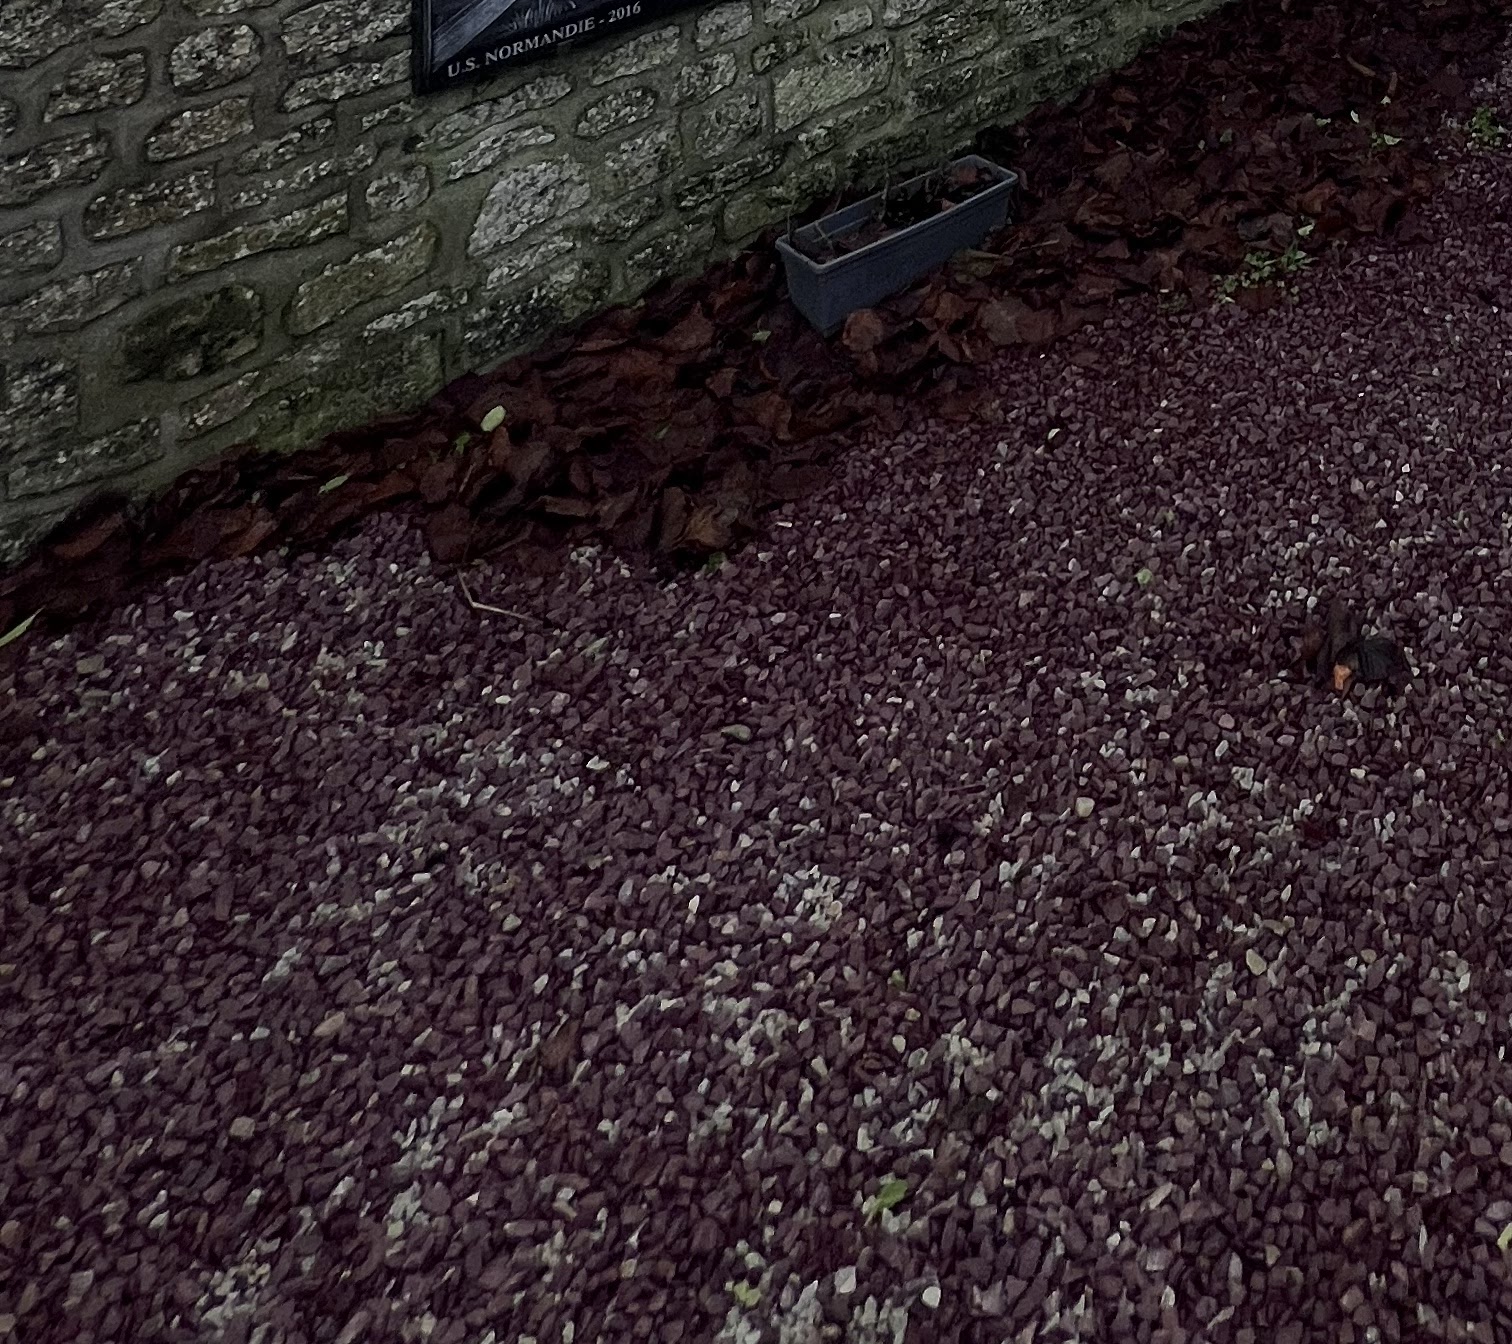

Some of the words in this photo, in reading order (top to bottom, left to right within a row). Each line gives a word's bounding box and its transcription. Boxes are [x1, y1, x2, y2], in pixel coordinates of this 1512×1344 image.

[446, 56, 481, 78] U.S.
[485, 16, 596, 62] NORMANDIE
[608, 1, 642, 23] 2016
